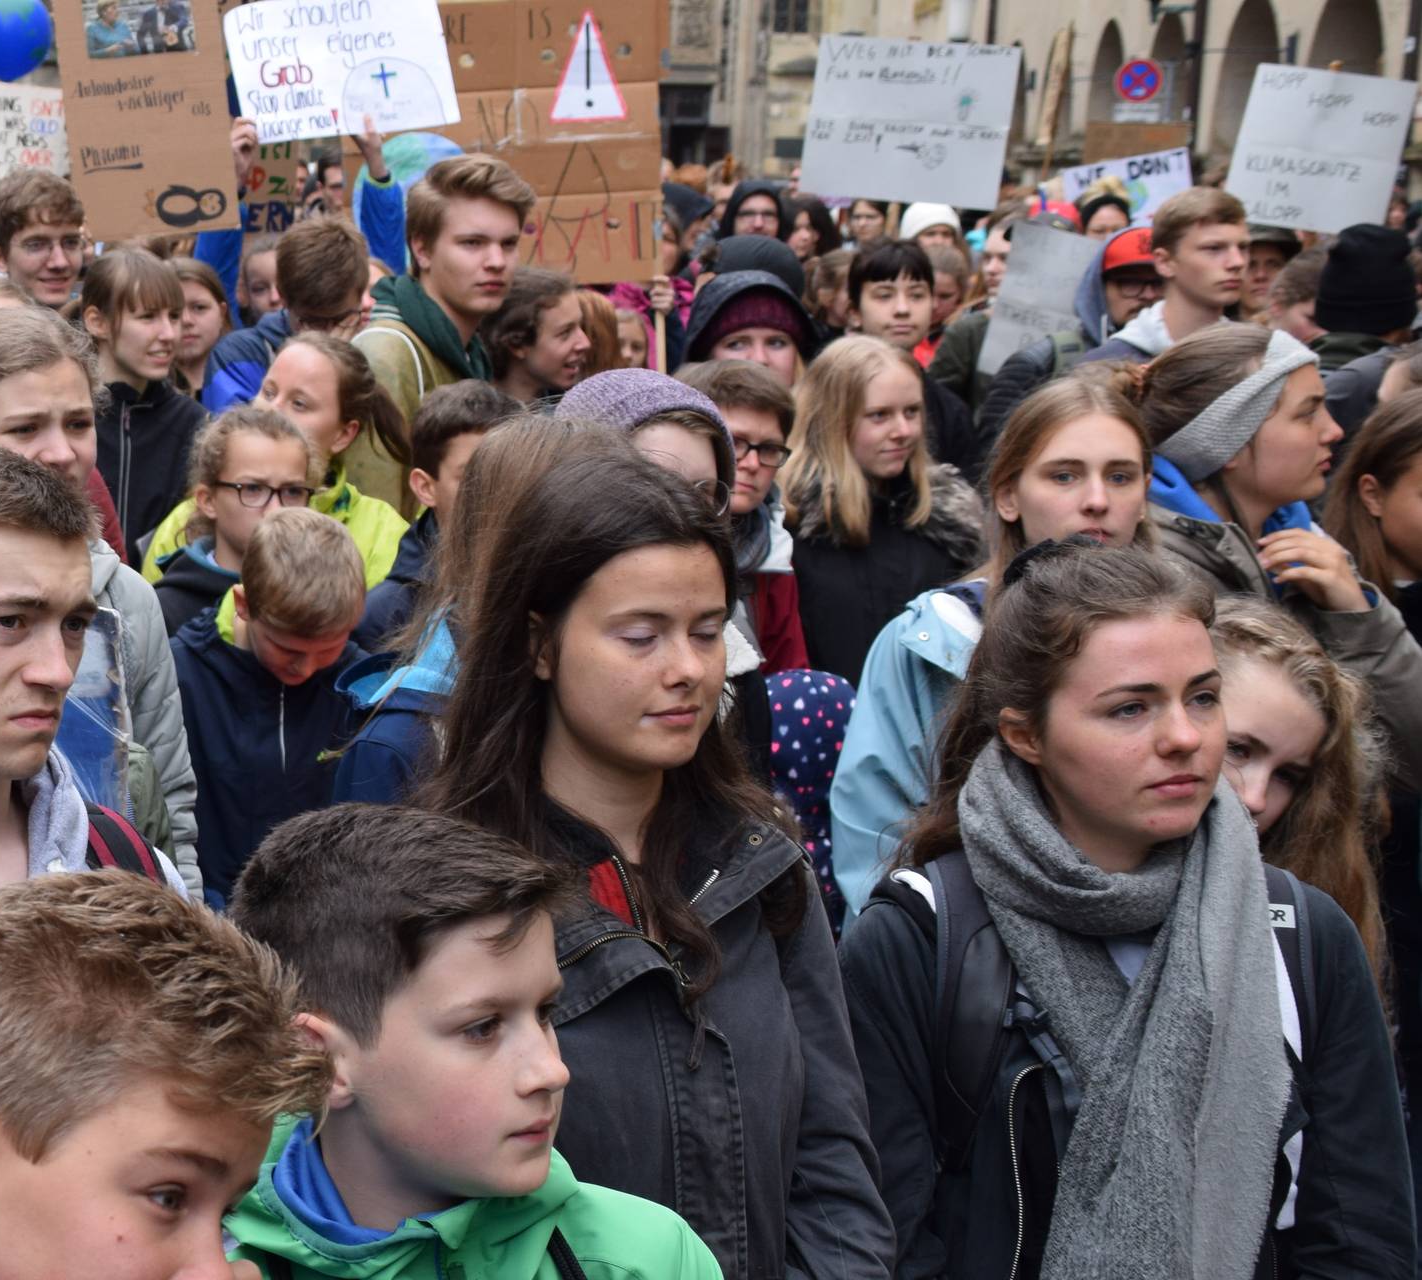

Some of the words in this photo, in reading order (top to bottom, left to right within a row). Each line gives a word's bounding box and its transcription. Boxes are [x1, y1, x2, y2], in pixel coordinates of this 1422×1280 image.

[235, 6, 264, 34] Wir
[284, 0, 372, 28] schaufeln
[241, 35, 299, 61] unser
[327, 31, 396, 69] eigenes
[260, 57, 313, 88] Grab
[1262, 72, 1308, 90] HOPP
[116, 89, 186, 112] wichtiger
[247, 89, 278, 117] Stop
[1308, 92, 1354, 109] HOPP
[30, 118, 59, 135] COLD
[261, 117, 303, 140] hange
[1362, 111, 1400, 128] HOPP
[15, 134, 49, 149] NEWS
[1245, 154, 1363, 182] KLIMASCHUTZ
[1265, 180, 1291, 197] IM
[1250, 201, 1303, 220] ALOPP
